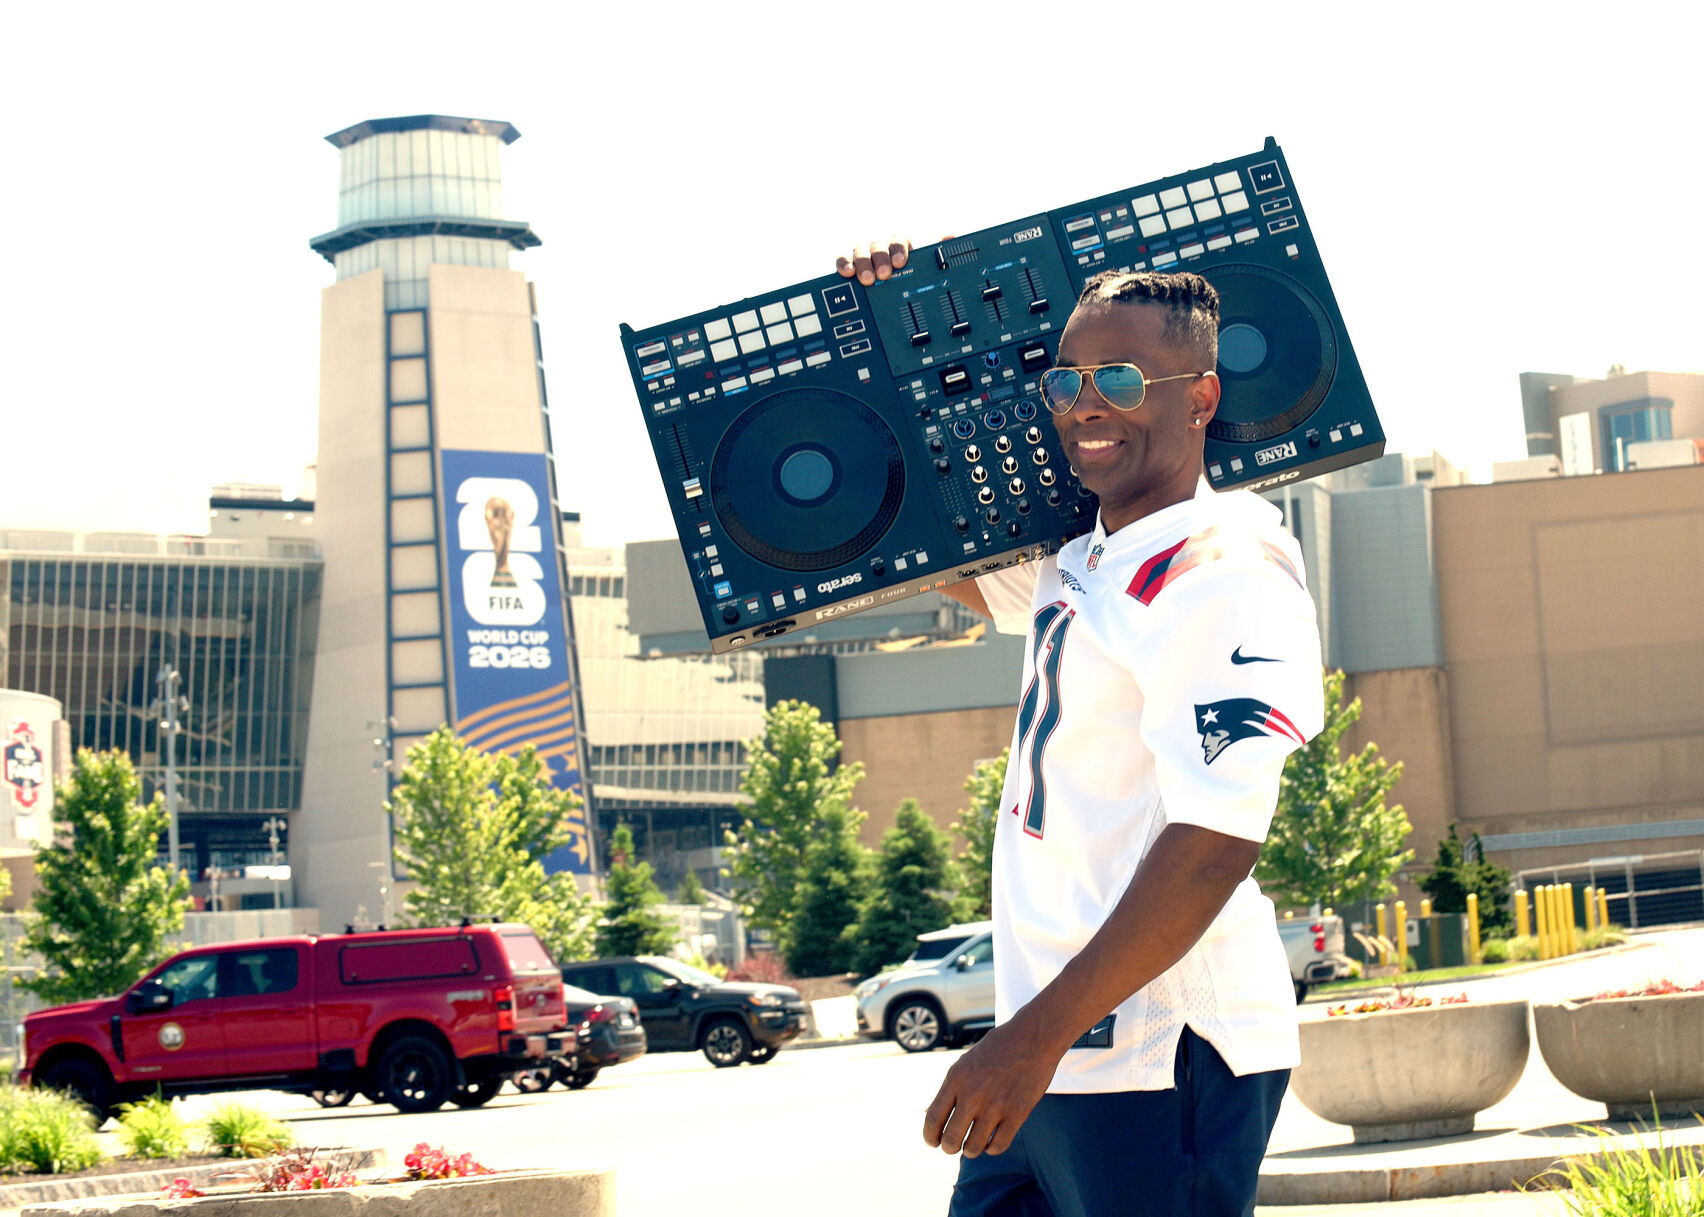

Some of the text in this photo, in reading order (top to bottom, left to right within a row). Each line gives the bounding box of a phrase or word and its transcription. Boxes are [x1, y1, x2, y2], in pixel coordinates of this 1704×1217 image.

[1014, 226, 1042, 244] RANE
[1255, 441, 1297, 466] RANE
[1242, 471, 1300, 491] erato
[817, 572, 863, 594] serato
[489, 596, 524, 610] FIFA
[815, 587, 906, 620] RANE FOUR
[467, 629, 550, 646] WORLD CUP
[468, 645, 552, 670] 2026
